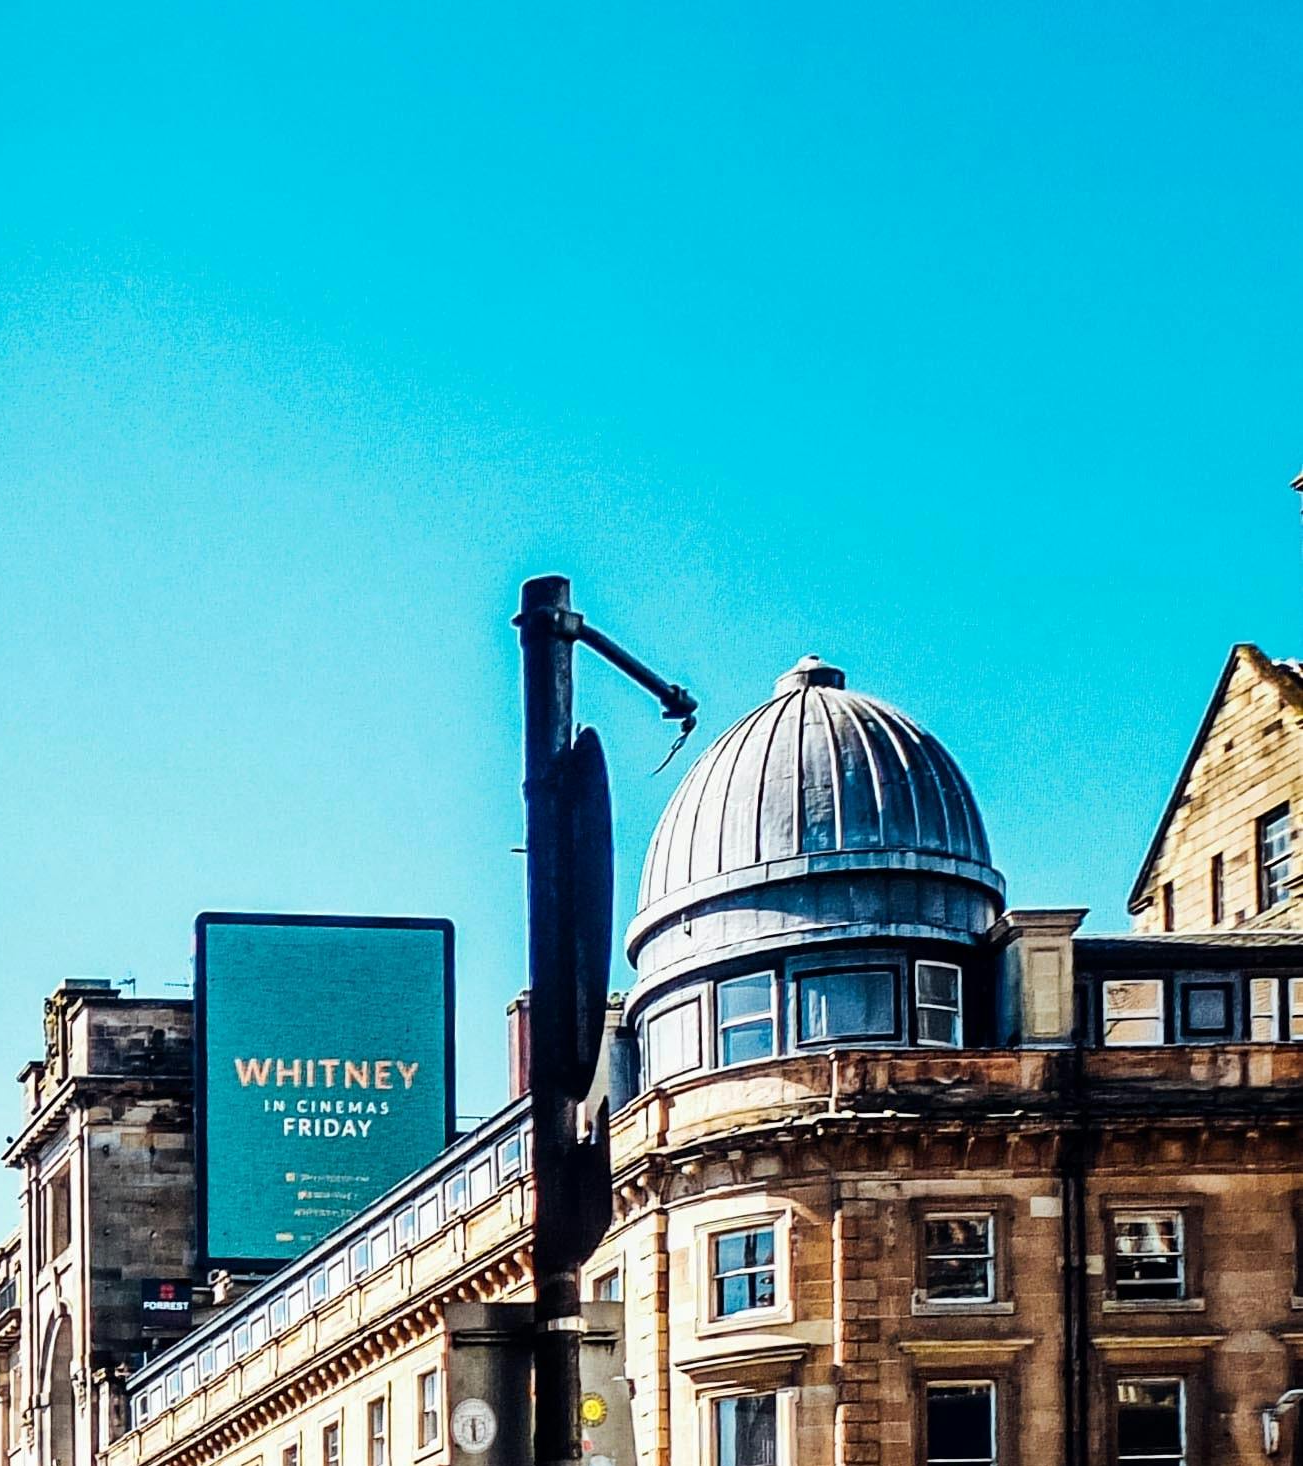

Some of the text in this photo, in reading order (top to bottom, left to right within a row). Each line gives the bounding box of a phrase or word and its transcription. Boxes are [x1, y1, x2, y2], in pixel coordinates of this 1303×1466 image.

[233, 1056, 420, 1090] WHITNEY
[263, 1099, 390, 1116] IN CINEMAS
[282, 1117, 373, 1139] FRIDAY
